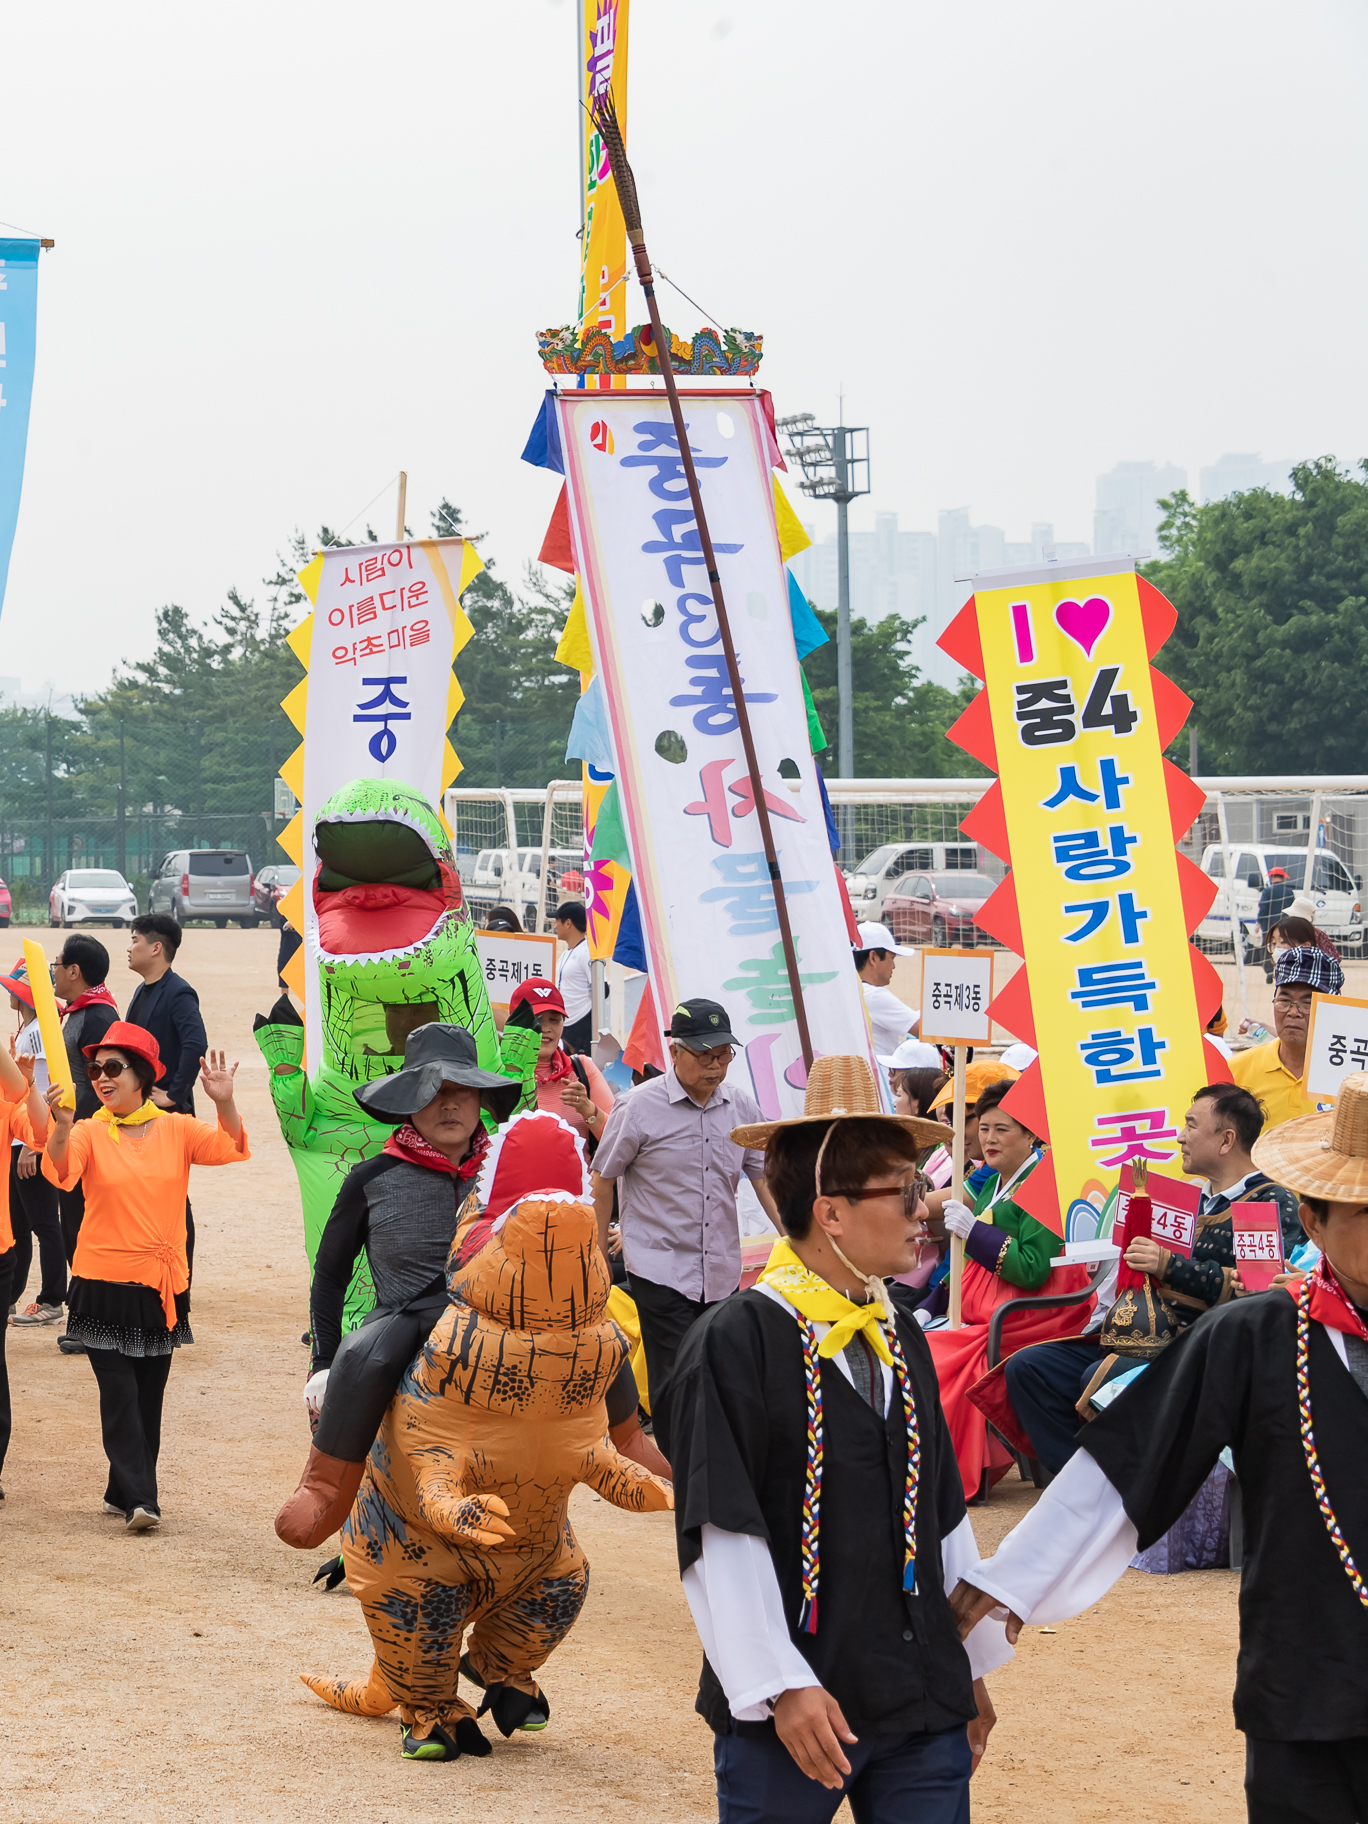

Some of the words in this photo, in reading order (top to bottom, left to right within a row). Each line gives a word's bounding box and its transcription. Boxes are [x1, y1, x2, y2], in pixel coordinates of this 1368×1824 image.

[1011, 603, 1035, 664] I
[352, 676, 412, 764] 중
[1015, 666, 1139, 747] 중4
[931, 981, 982, 1013] 중곡제3동
[1090, 1109, 1178, 1168] 곳
[1236, 1232, 1276, 1260] 중곡4동
